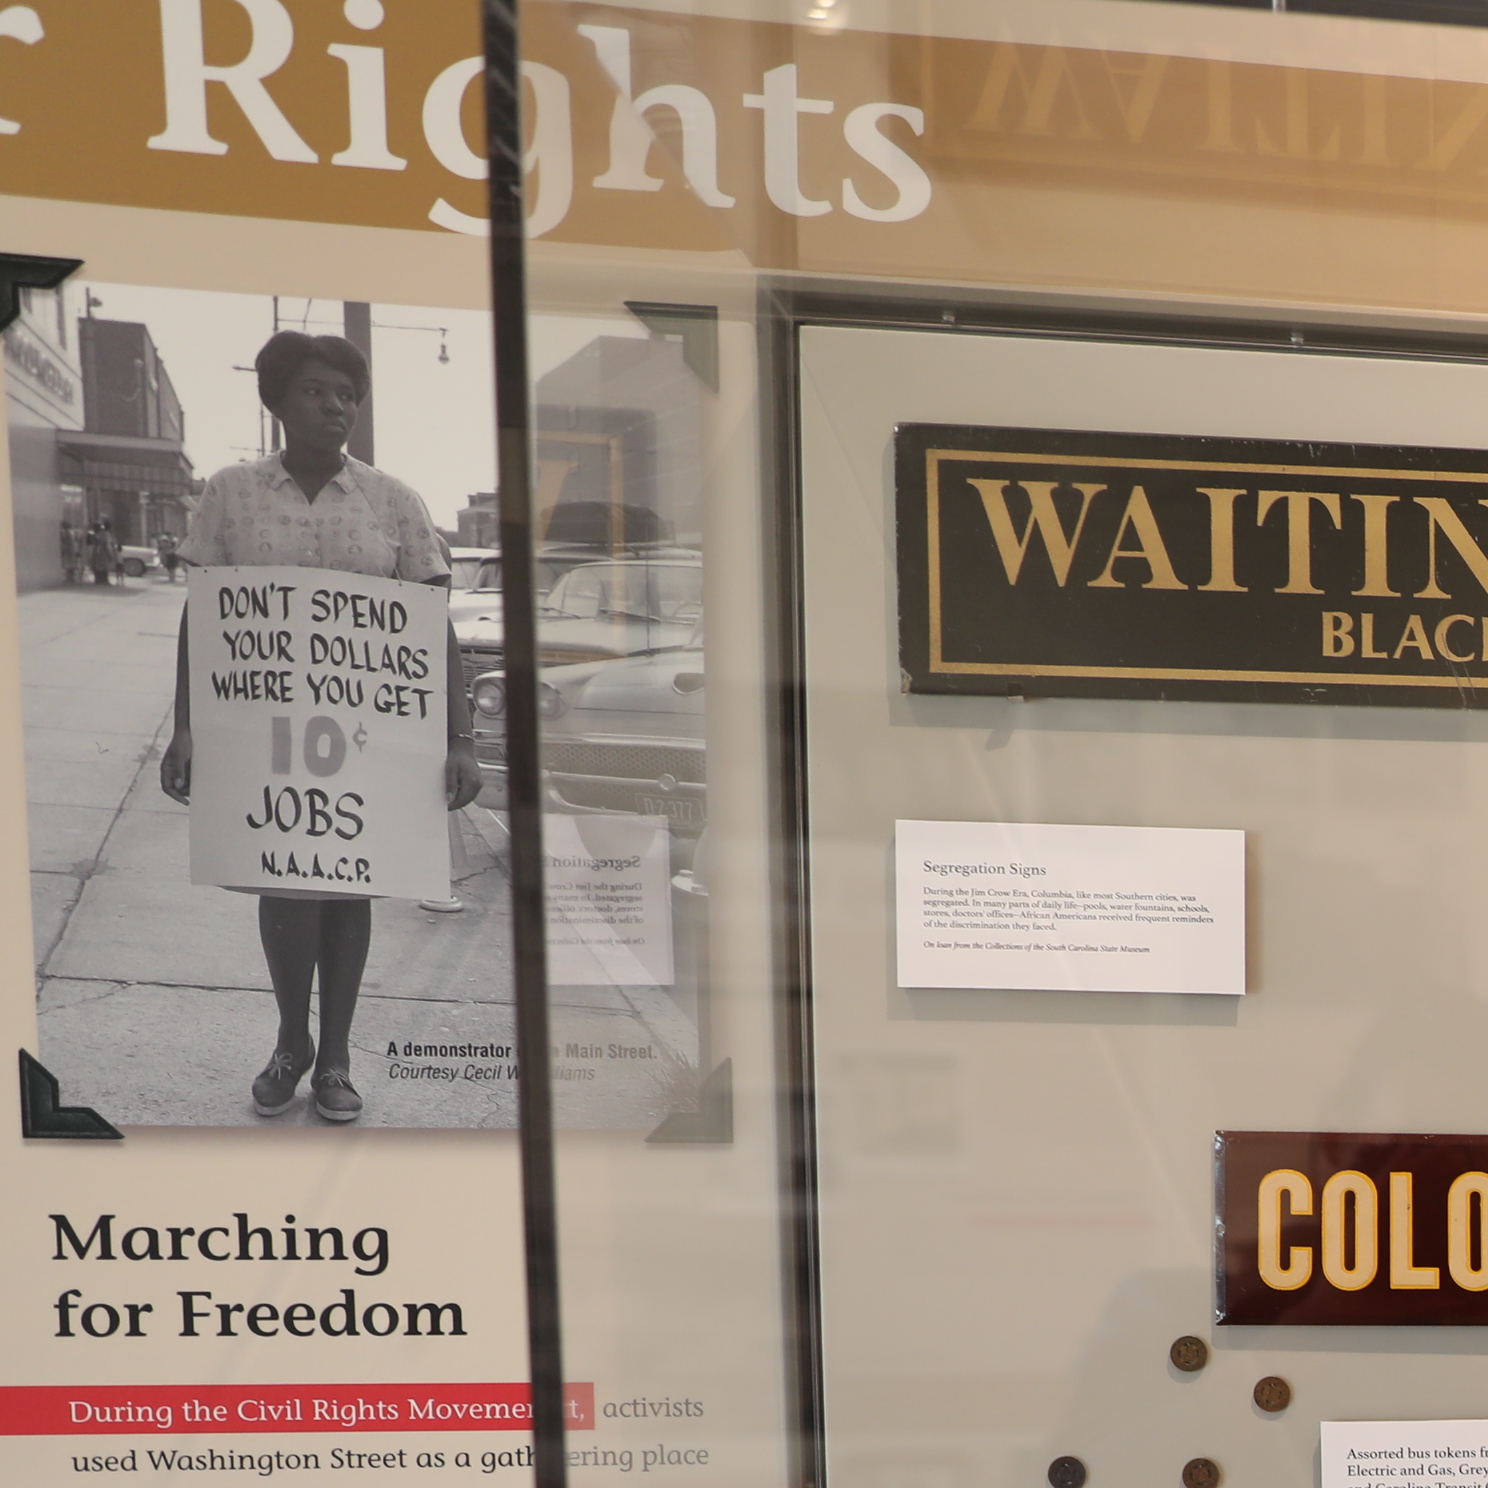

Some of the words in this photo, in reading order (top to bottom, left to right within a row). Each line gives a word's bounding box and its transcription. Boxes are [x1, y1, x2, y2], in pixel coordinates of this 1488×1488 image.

[148, 0, 932, 239] Rights
[217, 584, 297, 621] DON'T
[311, 590, 408, 635] SPEND
[222, 630, 296, 663] YOUR
[310, 633, 430, 680] DOLLARS
[211, 671, 294, 704] WHERE
[306, 674, 364, 709] YOU
[373, 684, 434, 720] GET
[270, 713, 369, 778] 10¢
[246, 785, 365, 841] JOBS
[261, 851, 372, 884] N.A.A.C.P.
[923, 861, 1006, 877] Segregation
[1009, 863, 1046, 878] Signs
[403, 1042, 512, 1058] demonstrator
[389, 1063, 458, 1083] Courtesy
[464, 1064, 501, 1080] Cecil
[48, 1212, 391, 1277] Marching
[53, 1289, 154, 1338] for
[178, 1289, 468, 1338] Freedom
[69, 1400, 172, 1429] During
[182, 1399, 228, 1423] the
[237, 1398, 303, 1423] Civil
[312, 1397, 399, 1427] Rights
[602, 1395, 705, 1420] activists
[72, 1448, 137, 1474] used
[146, 1447, 320, 1478] Washington
[330, 1447, 407, 1471] Street
[415, 1452, 446, 1470] as
[642, 1444, 710, 1472] place
[1347, 1447, 1404, 1460] Assorted
[1408, 1447, 1431, 1460] bus
[1434, 1447, 1477, 1460] tokens
[1347, 1463, 1397, 1477] Electric
[1400, 1463, 1424, 1476] and
[1427, 1464, 1456, 1477] Gas,
